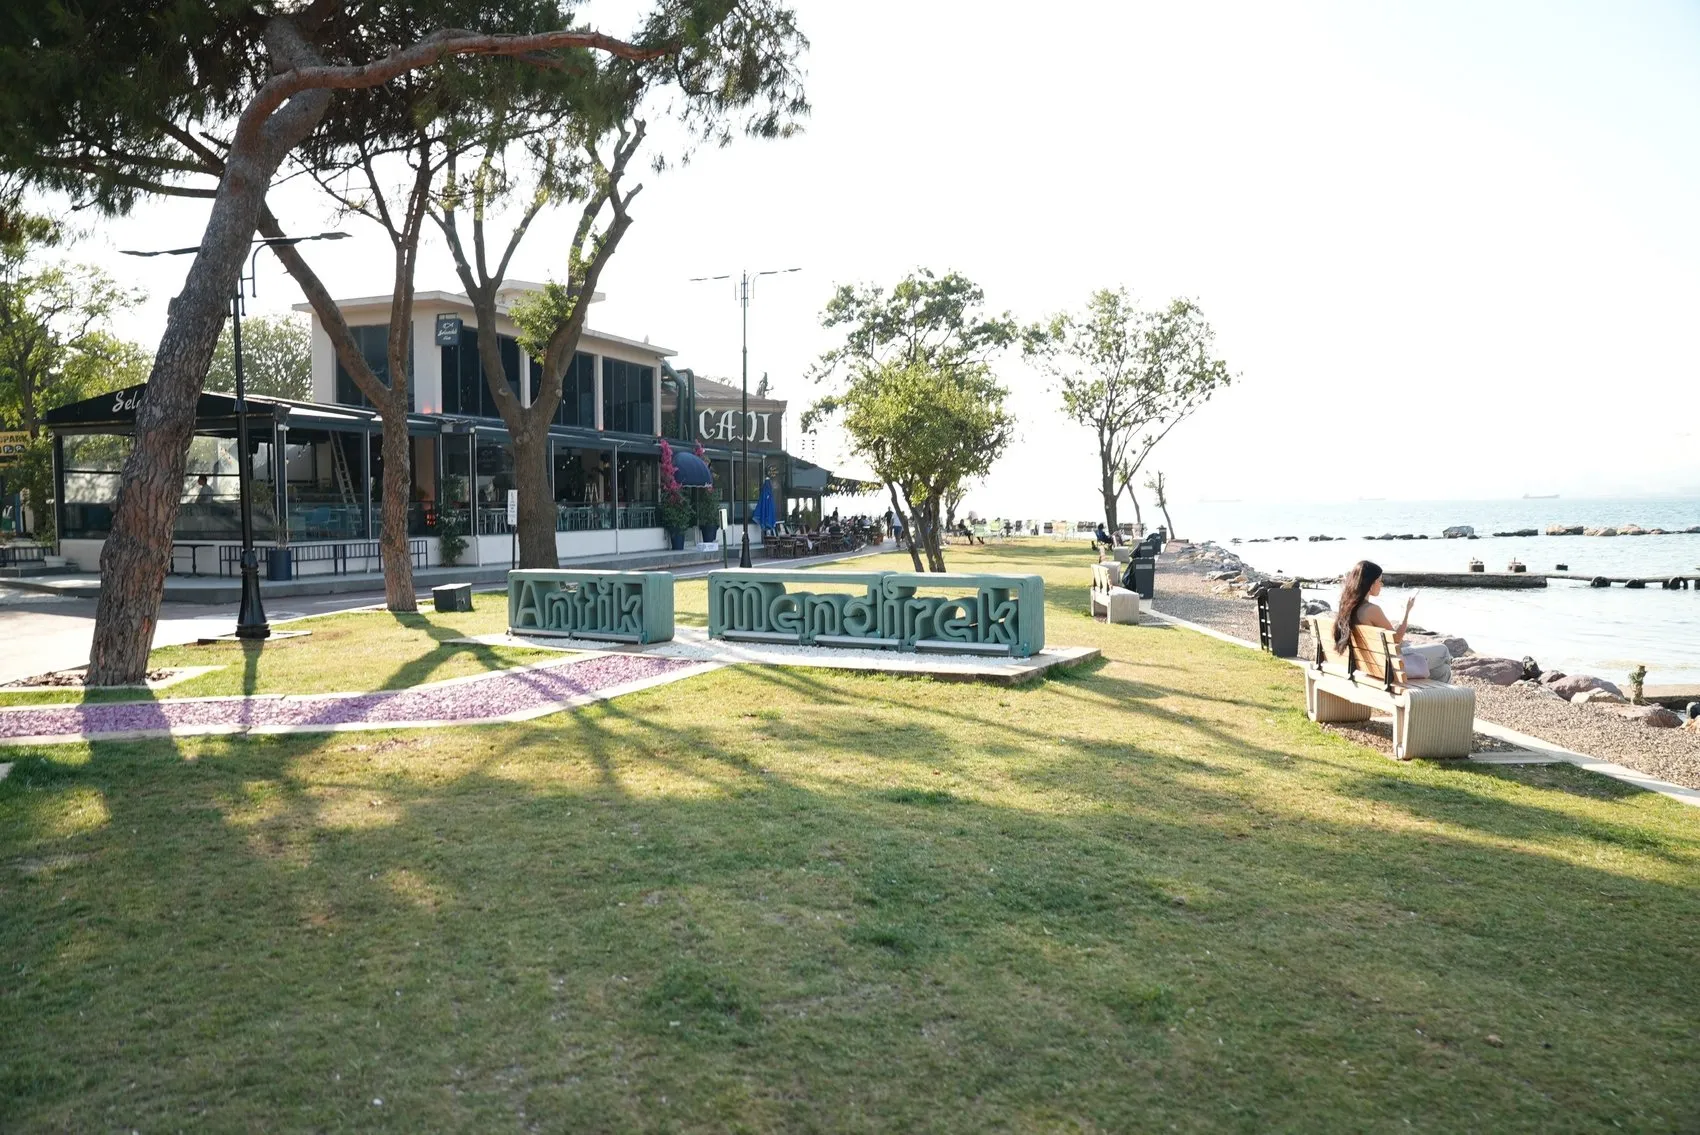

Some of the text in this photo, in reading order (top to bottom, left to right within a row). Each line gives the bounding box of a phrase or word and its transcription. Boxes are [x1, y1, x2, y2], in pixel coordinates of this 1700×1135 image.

[699, 407, 773, 443] CADI
[514, 579, 642, 634] Antik
[718, 581, 1019, 645] Mendirek
